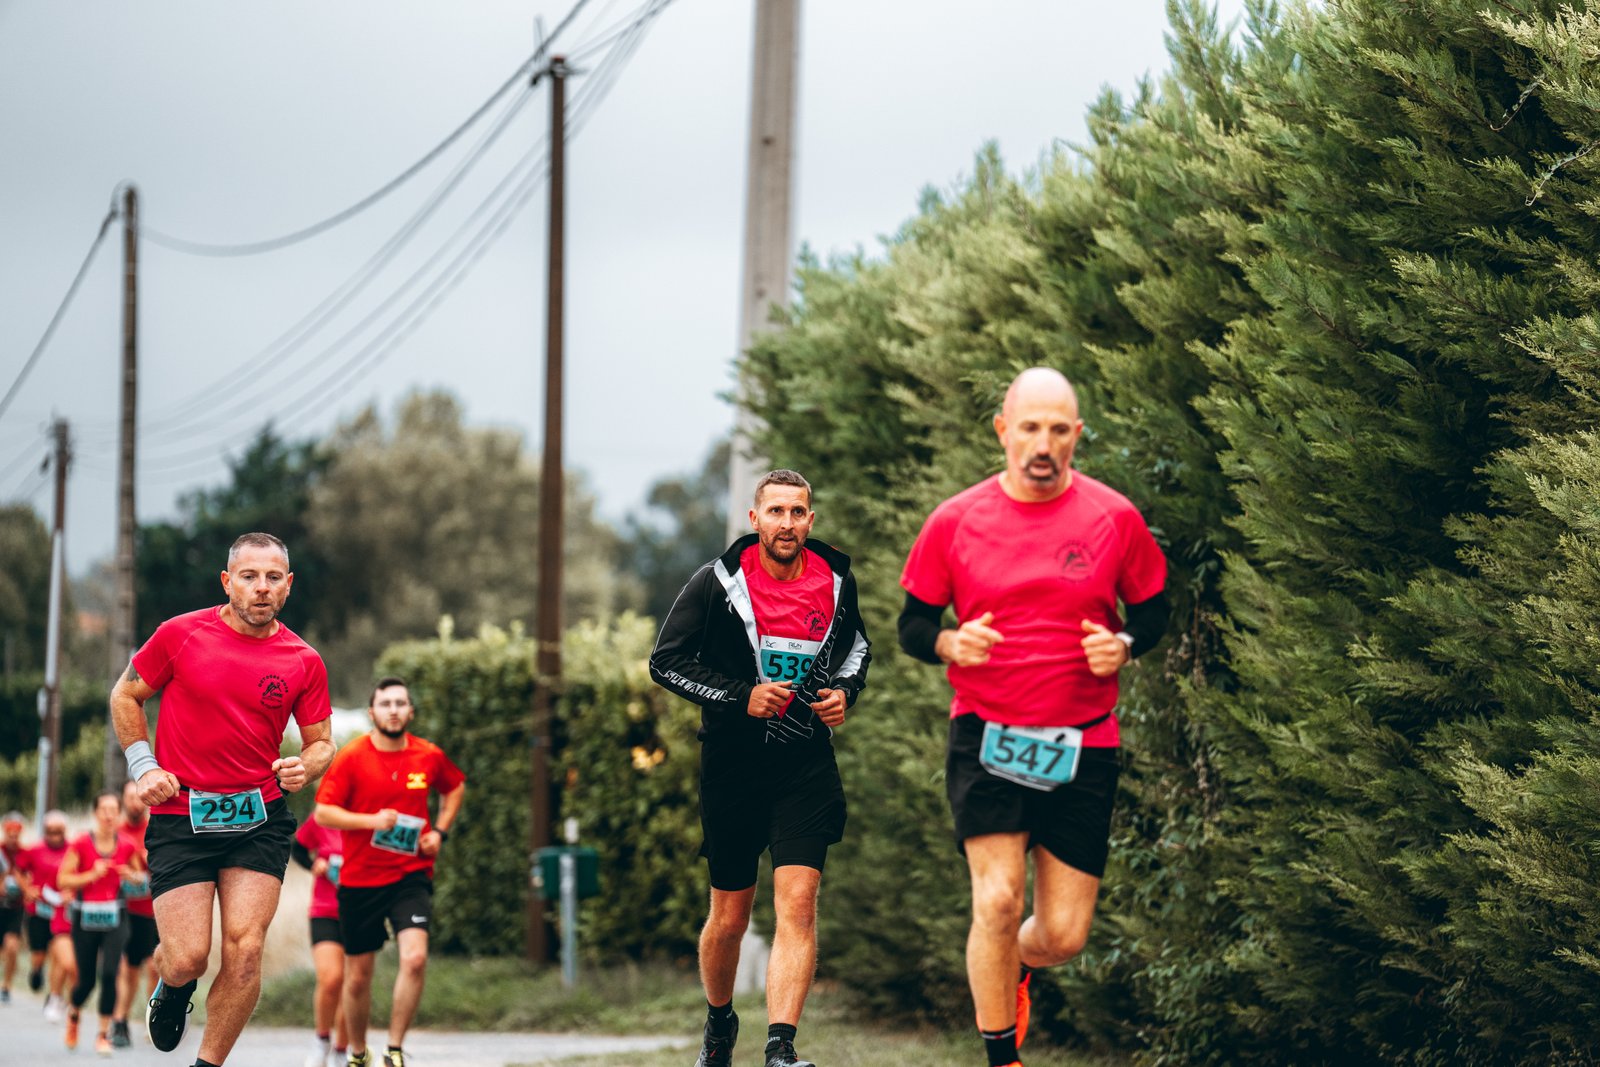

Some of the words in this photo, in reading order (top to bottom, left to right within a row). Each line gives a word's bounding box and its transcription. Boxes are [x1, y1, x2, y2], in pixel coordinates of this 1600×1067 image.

[767, 654, 813, 682] 539
[993, 735, 1064, 775] 547
[200, 796, 256, 823] 294
